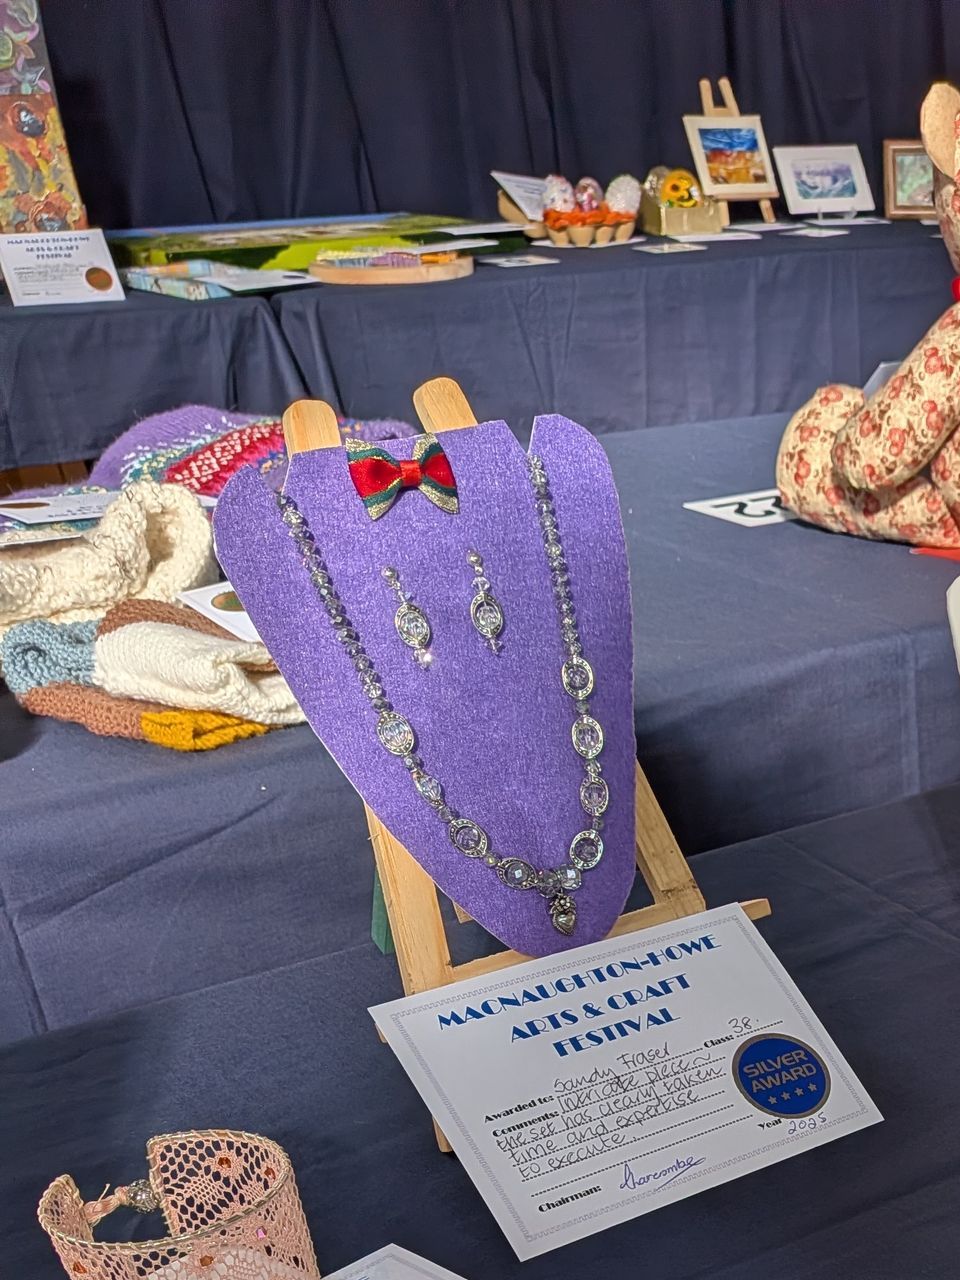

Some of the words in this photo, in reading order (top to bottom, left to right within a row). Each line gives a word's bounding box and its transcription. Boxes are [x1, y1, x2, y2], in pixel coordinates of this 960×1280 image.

[437, 934, 722, 1030] MACNAUGHTON-HOWE
[511, 1009, 579, 1043] ARTS
[581, 1002, 605, 1018] &
[607, 972, 691, 1010] CRAFT
[552, 1007, 681, 1057] FESTIVAL
[703, 1034, 735, 1049] Class:
[743, 1050, 808, 1078] SILVER
[751, 1063, 816, 1093] AWARD
[484, 1098, 536, 1123] Awarded
[537, 1095, 554, 1107] to:
[529, 1121, 556, 1141] set
[561, 1109, 593, 1131] has
[662, 1067, 723, 1092] taken
[492, 1110, 559, 1138] Comments:
[758, 1118, 782, 1130] Year
[788, 1112, 827, 1134] 2025
[508, 1138, 559, 1164] time
[565, 1119, 609, 1144] and
[519, 1161, 541, 1179] to
[538, 1185, 602, 1213] Chairman:
